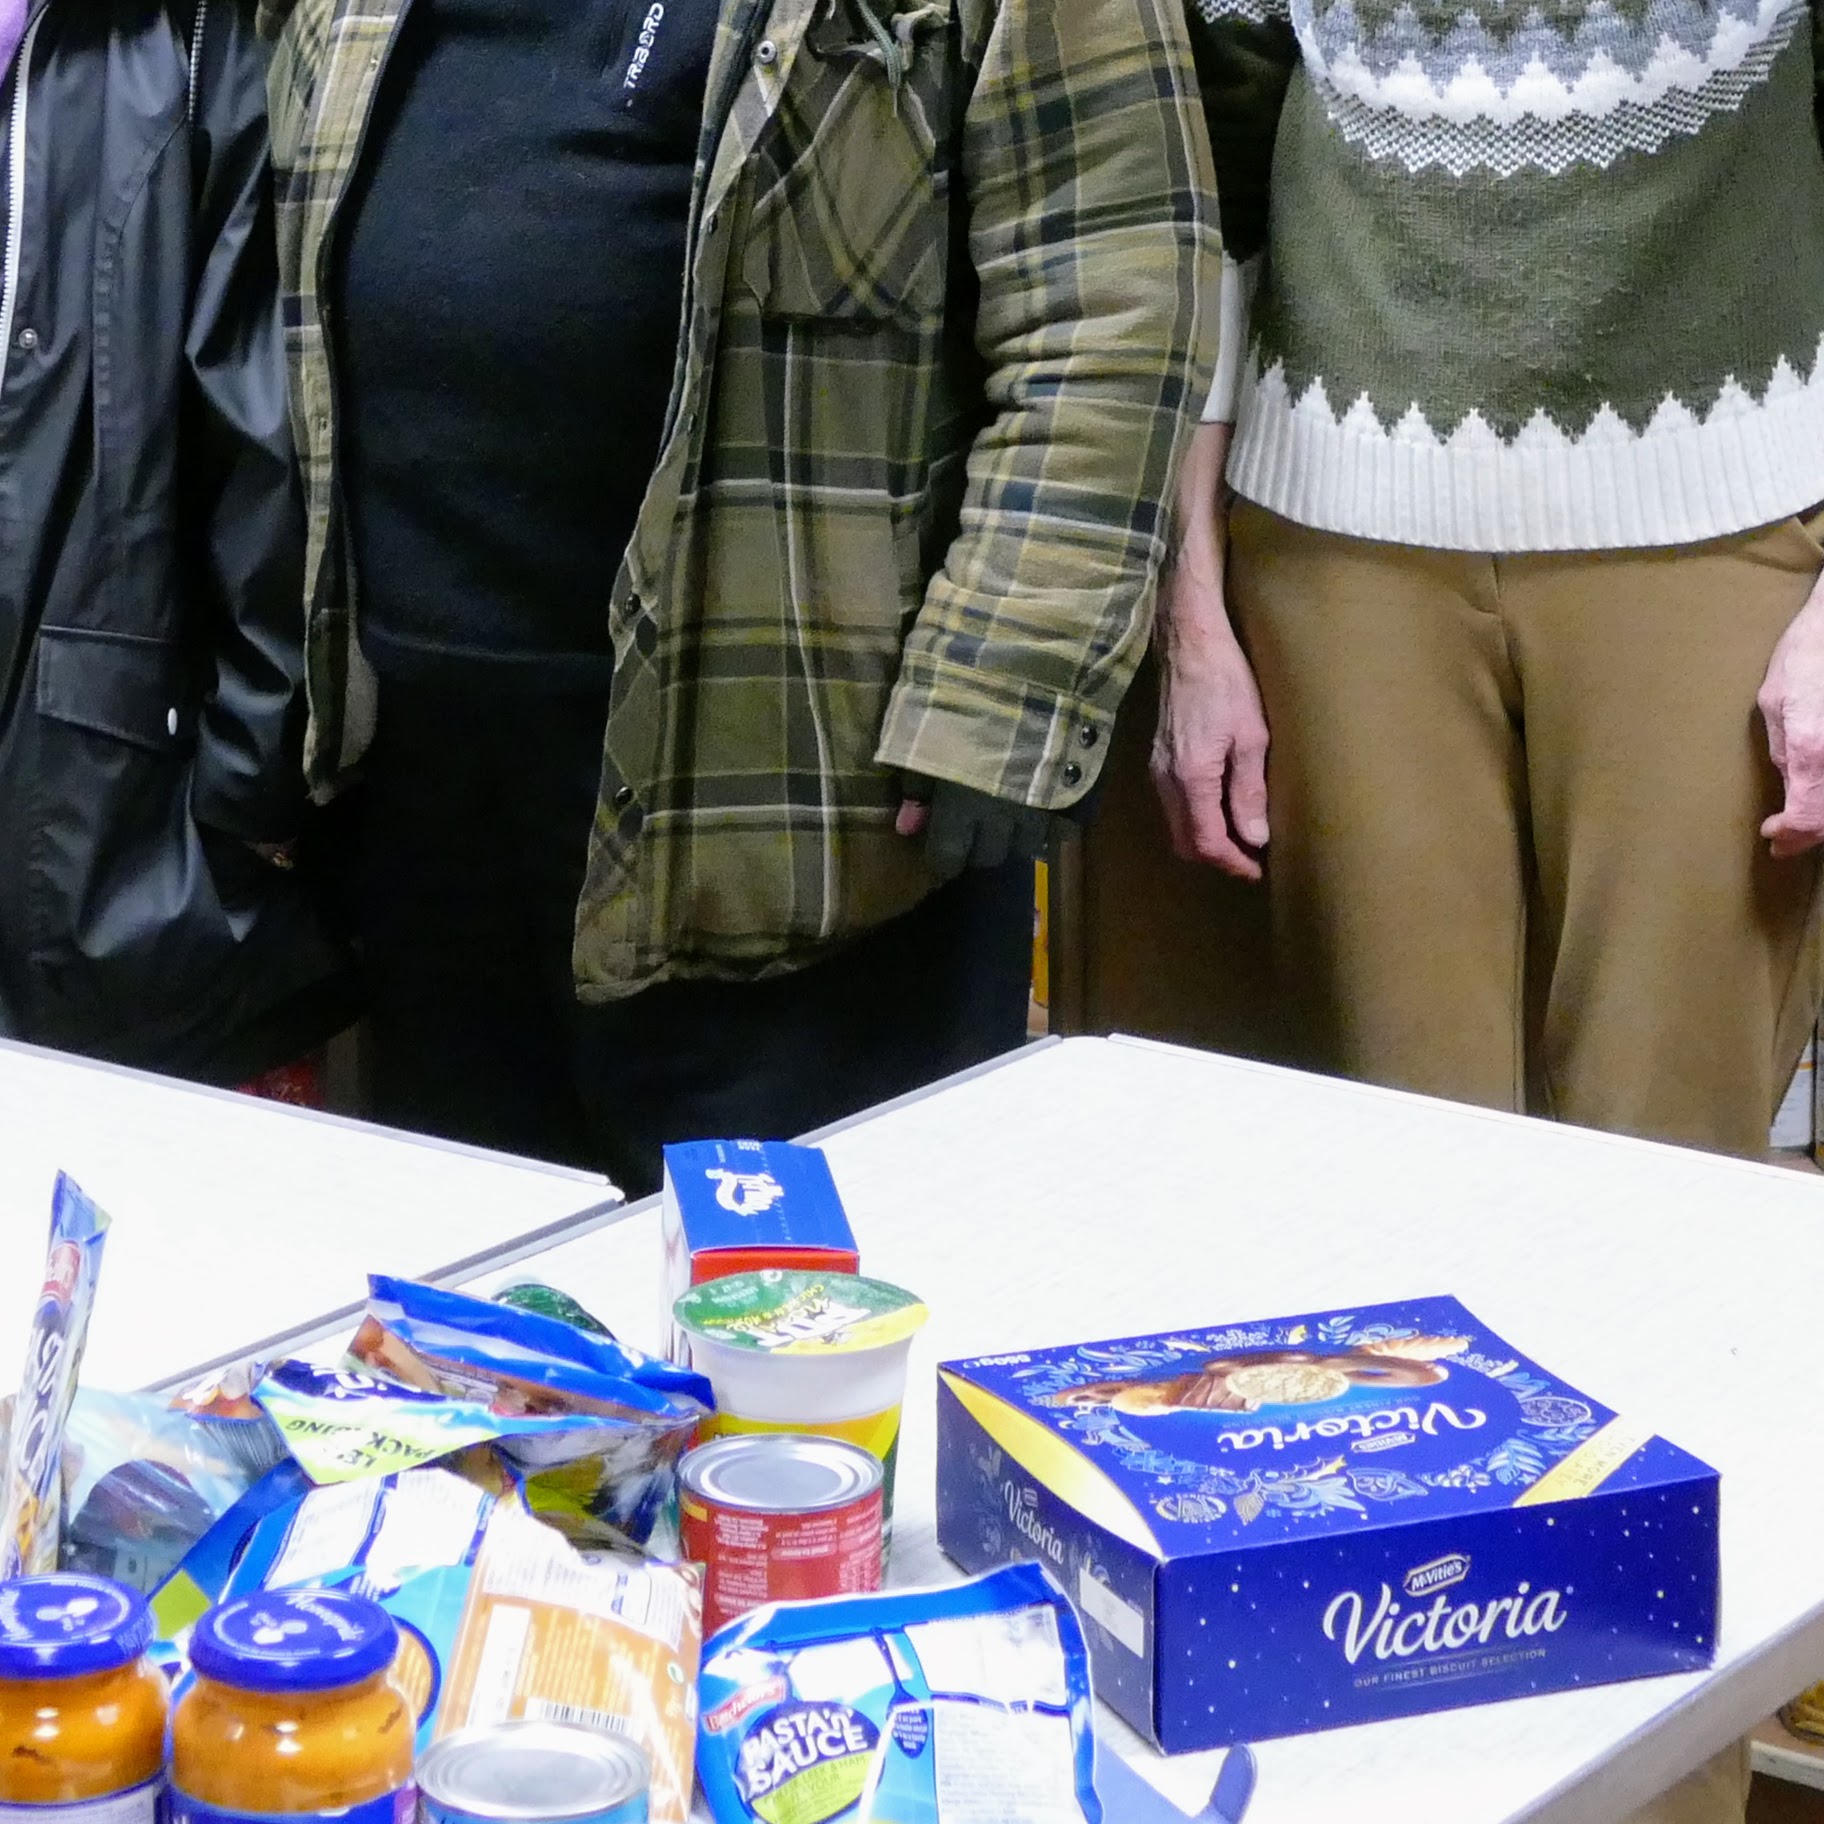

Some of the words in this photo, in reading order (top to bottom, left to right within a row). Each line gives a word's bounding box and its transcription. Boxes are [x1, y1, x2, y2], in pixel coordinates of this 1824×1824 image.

[623, 2, 665, 90] TRIBORD
[1217, 1402, 1487, 1454] Victoria
[1002, 1479, 1065, 1565] Victoria
[1322, 1581, 1568, 1665] Victoria
[1353, 1676, 1379, 1688] OUR
[1382, 1667, 1425, 1682] FINEST
[1429, 1659, 1477, 1676] BISCUIT
[1481, 1648, 1547, 1668] SELECTION
[746, 1725, 868, 1800] SAUCE
